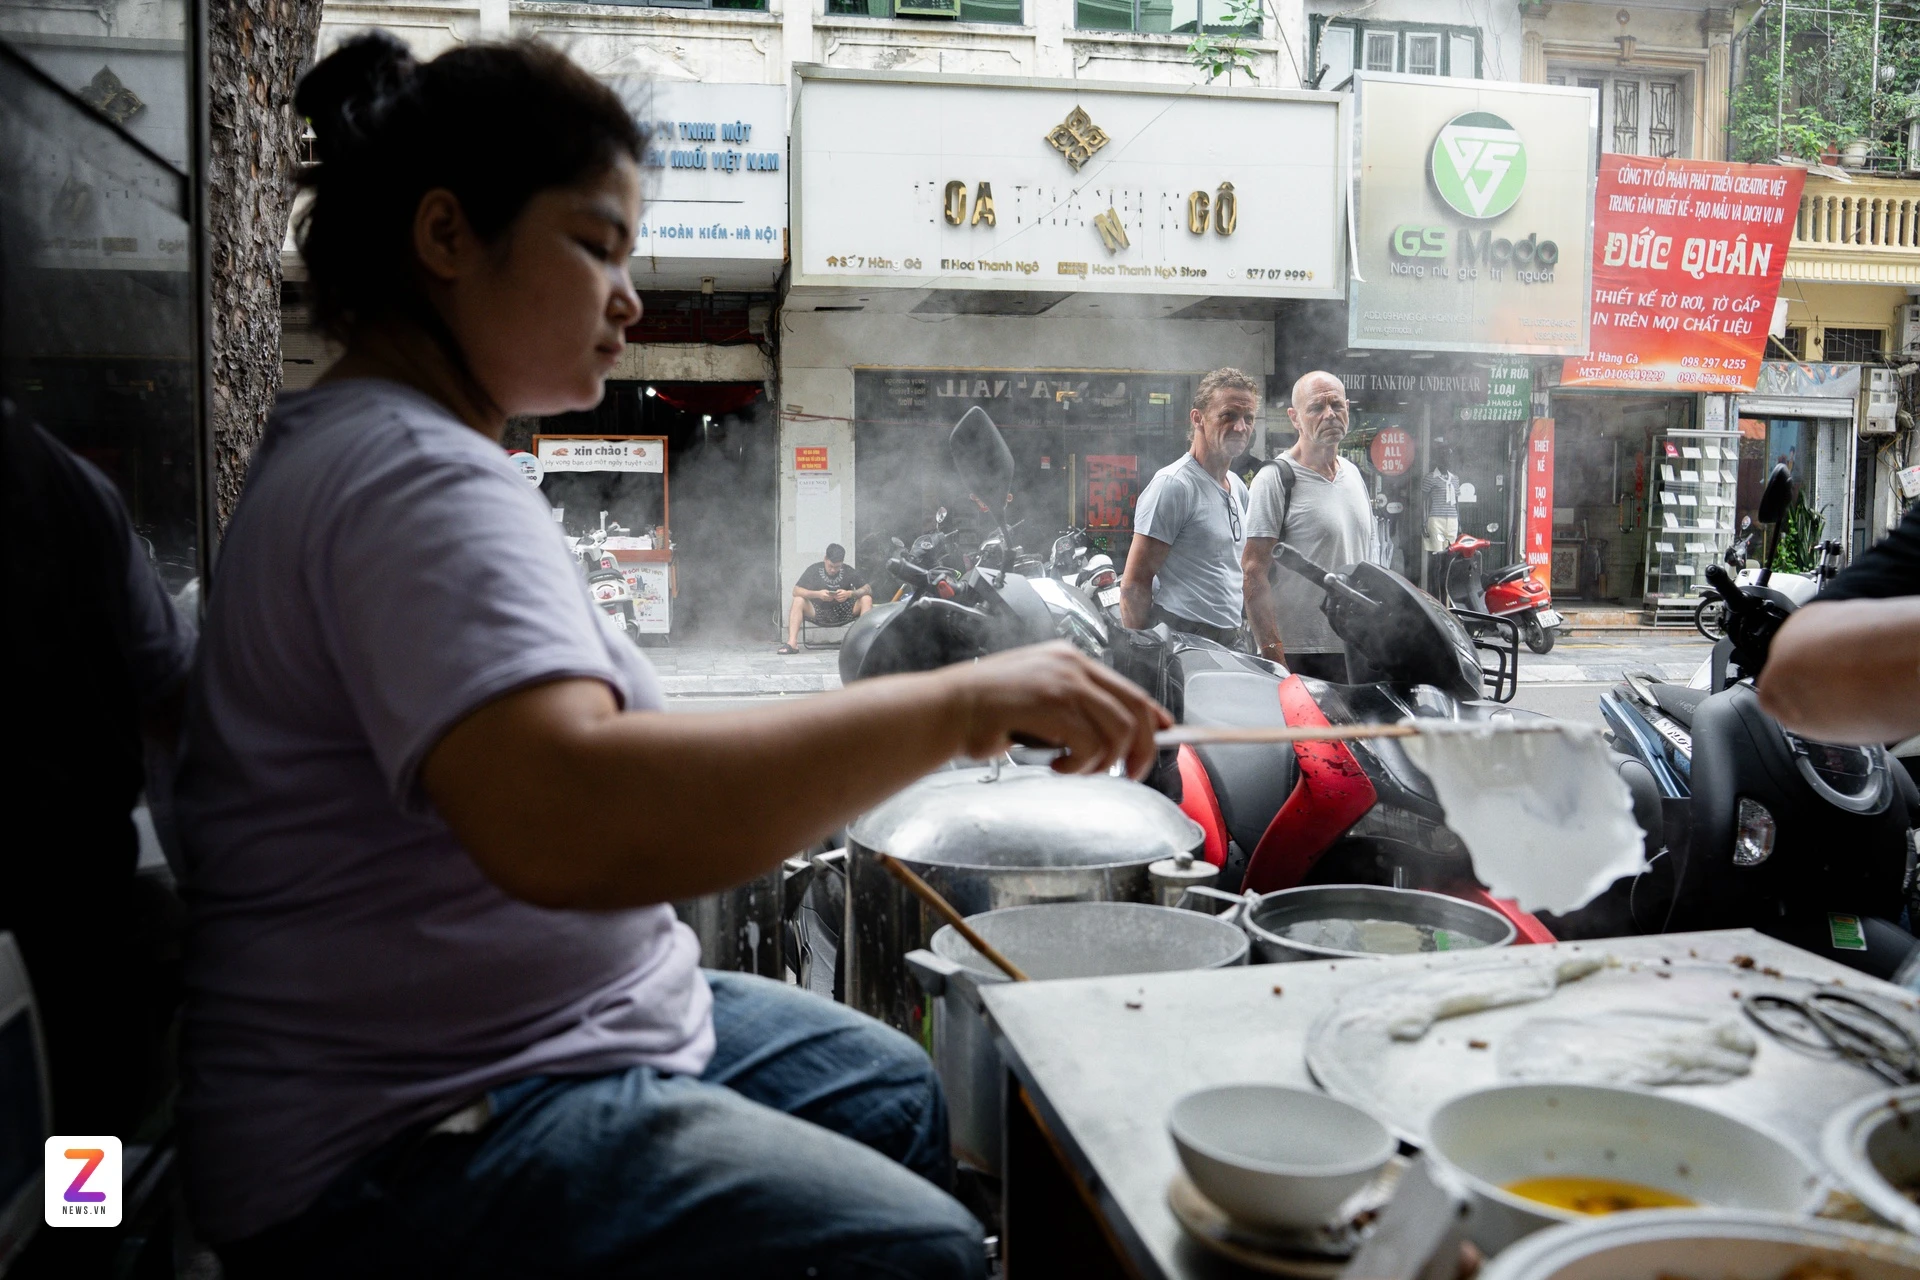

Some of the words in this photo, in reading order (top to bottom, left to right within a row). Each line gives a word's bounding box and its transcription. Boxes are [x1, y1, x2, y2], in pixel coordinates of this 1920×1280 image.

[679, 122, 716, 141] TNHH
[721, 120, 752, 145] MỘT
[670, 145, 708, 169] MUỐI
[711, 149, 742, 174] VIỆT
[746, 152, 780, 171] NAM
[1618, 164, 1641, 185] CÔNG
[1643, 169, 1653, 186] TY
[1653, 162, 1667, 187] CỔ
[1689, 168, 1711, 191] PHÁT
[1711, 167, 1735, 193] TRIỂN
[1734, 177, 1770, 196] CREATIVE
[1769, 175, 1788, 200] VIỆT
[1608, 195, 1635, 212] TRUNG
[1636, 193, 1655, 214] TÂM
[1655, 193, 1678, 216] THIẾT
[1677, 193, 1692, 217] KẾ
[1694, 201, 1712, 221] TẠO
[1712, 196, 1730, 220] MẪU
[1731, 199, 1743, 221] VÀ
[1742, 205, 1763, 225] DỊCH
[1763, 206, 1775, 227] VỤ
[1775, 207, 1785, 224] IN
[660, 223, 693, 239] HOÀN
[699, 223, 728, 239] KIẾM
[736, 225, 751, 240] HÀ
[755, 226, 777, 244] NỘI
[1394, 224, 1449, 259] GS
[1457, 228, 1559, 265] Moda
[1603, 226, 1673, 270] ĐỨC
[1681, 233, 1773, 280] QUÂN
[840, 254, 856, 267] Số
[858, 257, 864, 267] 7
[868, 257, 901, 271] Hàng
[903, 257, 922, 269] Gà
[951, 259, 975, 271] Hoa
[978, 260, 1013, 272] Thanh
[1016, 260, 1040, 275] Ngô
[1092, 264, 1115, 276] Hoa
[1118, 265, 1151, 277] Thanh
[1154, 265, 1178, 280] Ngô
[1180, 266, 1207, 278] Store
[1268, 269, 1281, 280] 07
[1390, 262, 1424, 277] Nâng
[1458, 265, 1478, 281] giá
[1595, 287, 1634, 305] THIẾT
[1637, 289, 1658, 307] KẾ
[1661, 292, 1678, 308] TỜ
[1680, 295, 1706, 313] RƠI,
[1712, 294, 1729, 311] TỜ
[1731, 294, 1761, 313] GẤP
[1592, 312, 1609, 326] IN
[1613, 311, 1649, 328] TRÊN
[1652, 316, 1679, 333] MỌI
[1683, 313, 1719, 333] CHẤT
[1723, 319, 1752, 336] LIỆU
[1597, 352, 1623, 365] Hàng
[1625, 352, 1639, 364] Gà
[1681, 356, 1699, 367] 098
[1701, 357, 1719, 368] 297
[1722, 358, 1747, 370] 4255
[1370, 374, 1416, 391] TANKTOP
[1420, 375, 1481, 392] UNDERWEAR
[1677, 372, 1696, 383] 098
[1697, 373, 1716, 384] 472
[1718, 374, 1742, 386] 1881
[1494, 384, 1516, 397] LOẠI
[1381, 433, 1405, 444] SALE
[1534, 435, 1550, 452] THIẾT
[574, 445, 592, 456] xin
[595, 445, 621, 456] chào
[1384, 446, 1402, 457] ALL
[1382, 460, 1404, 470] 30%
[1537, 455, 1545, 471] KẾ
[1535, 487, 1547, 502] TẠO
[1533, 501, 1547, 518] MẪU
[1535, 533, 1542, 545] IN
[1528, 552, 1549, 564] NHANH
